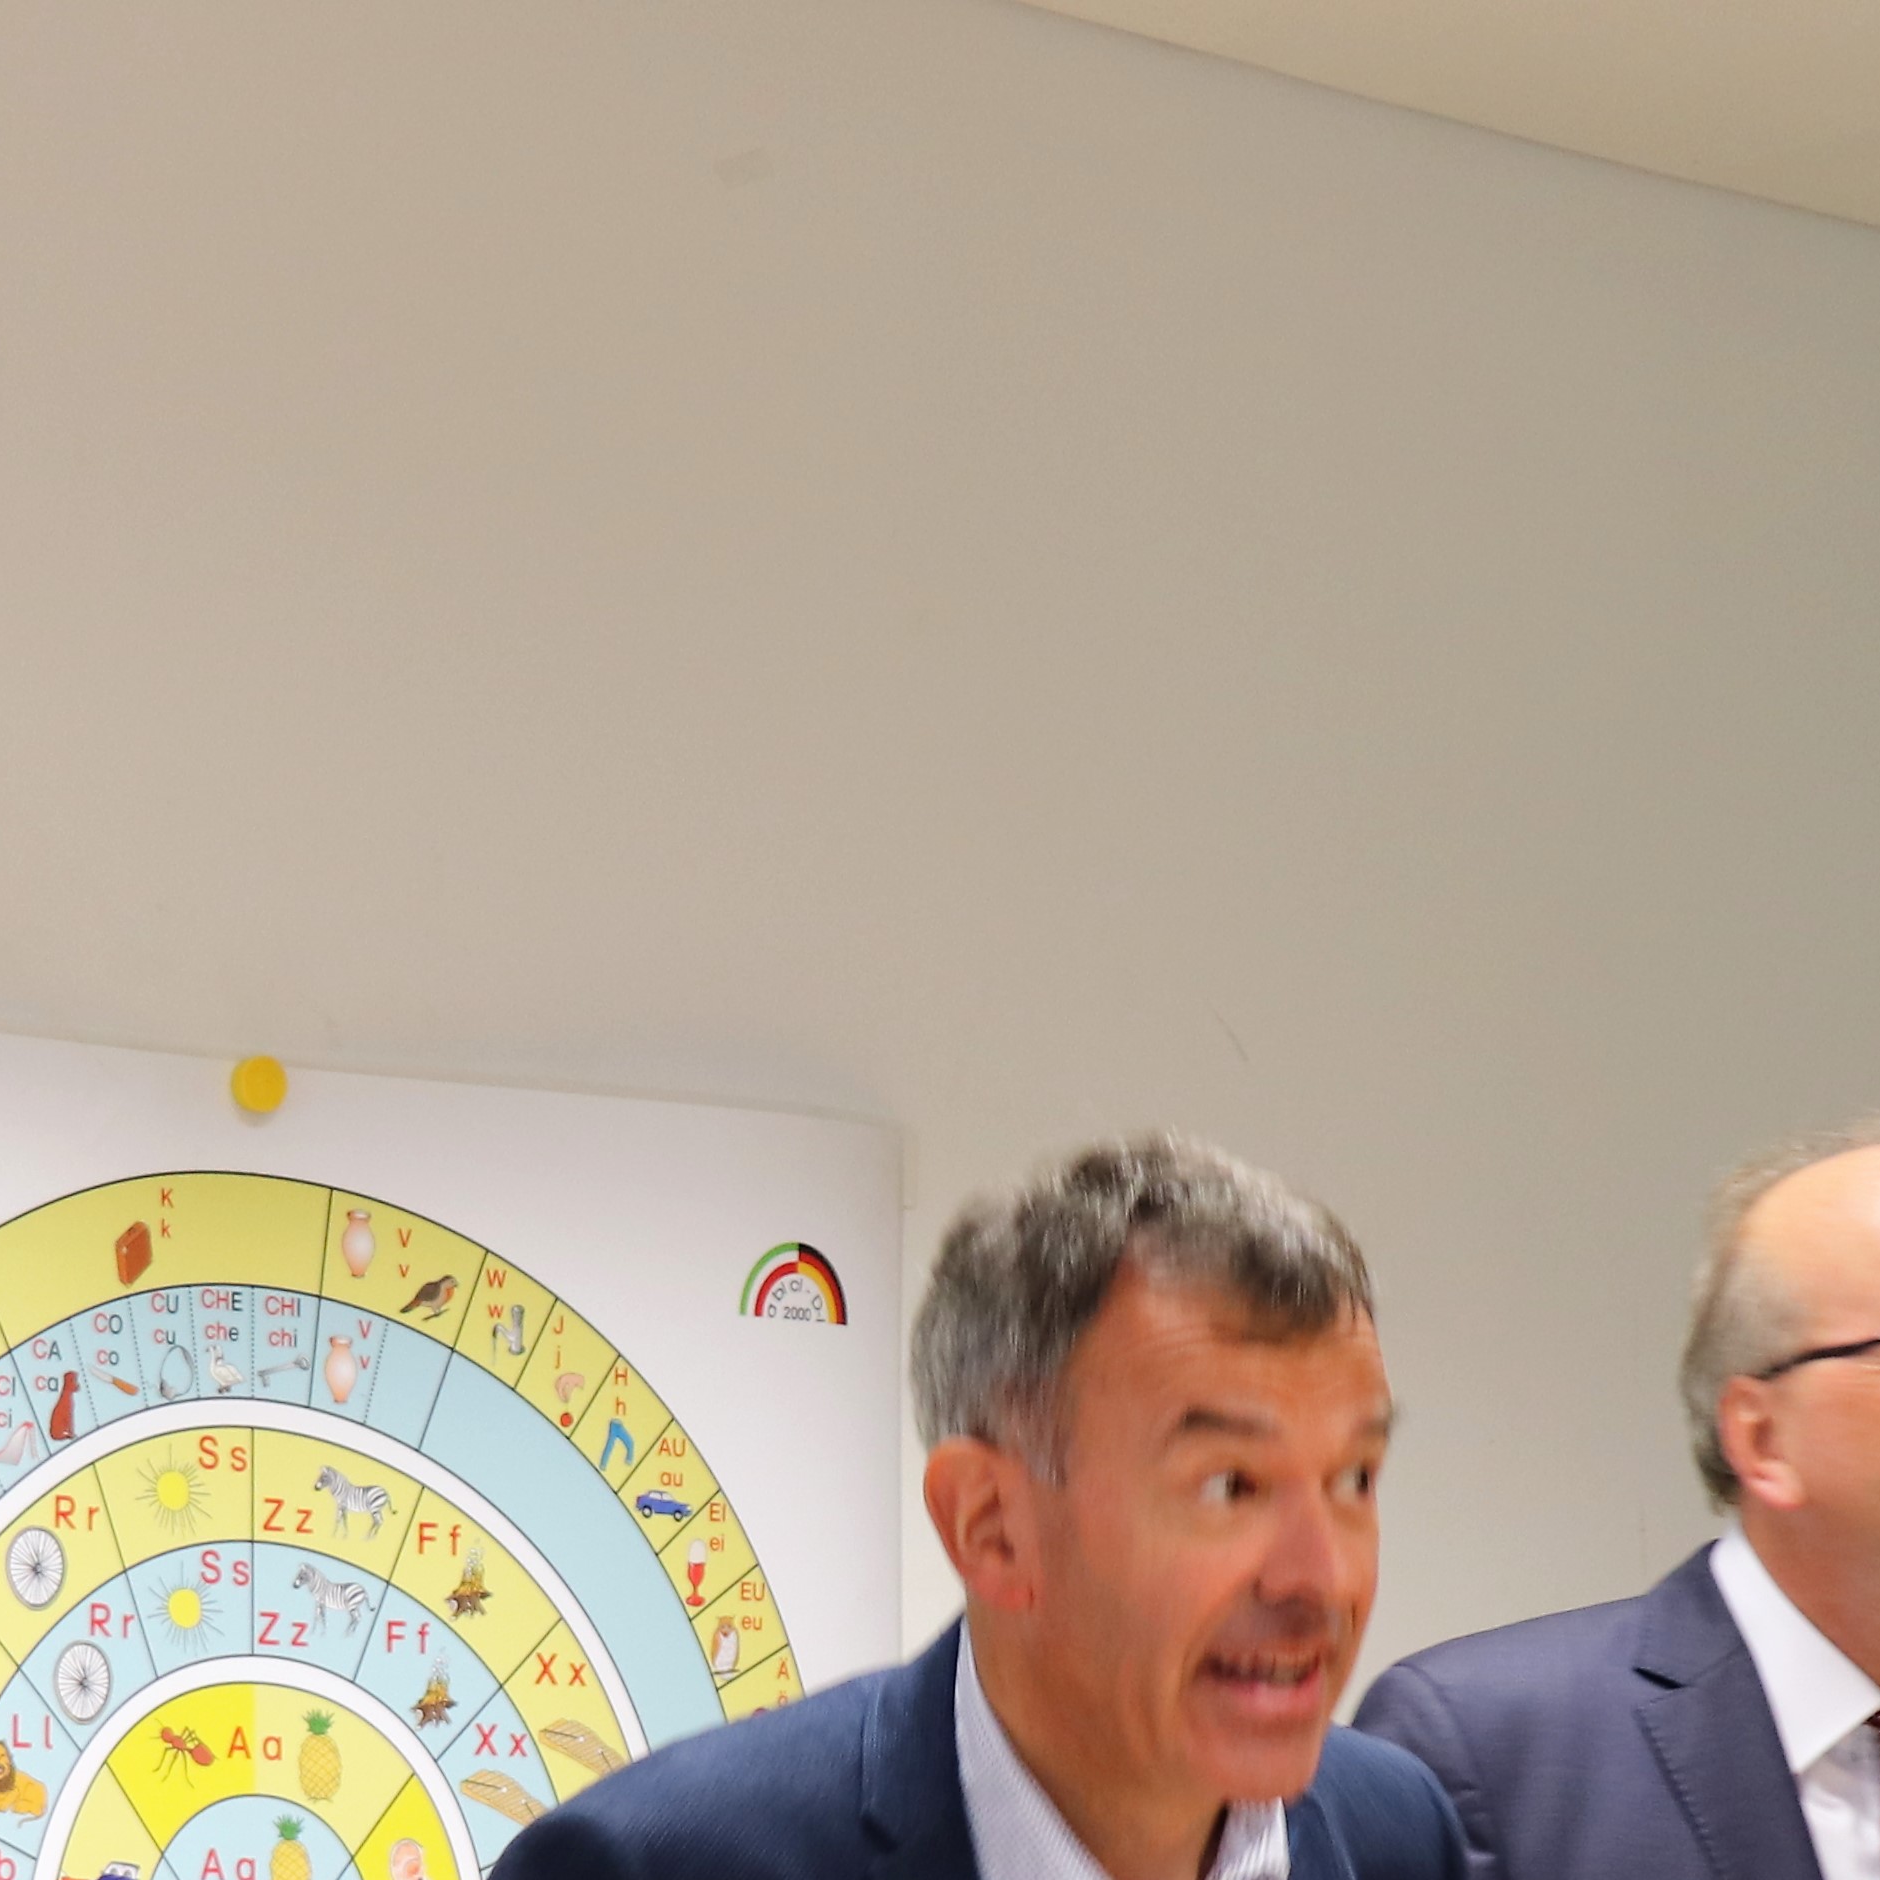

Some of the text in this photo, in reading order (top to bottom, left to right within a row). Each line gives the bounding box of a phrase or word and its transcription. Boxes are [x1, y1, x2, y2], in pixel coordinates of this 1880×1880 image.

[161, 1188, 173, 1207] K
[161, 1219, 170, 1238] k
[398, 1229, 411, 1248] V
[399, 1264, 409, 1278] v
[487, 1269, 506, 1288] W
[151, 1293, 179, 1314] CU
[202, 1289, 242, 1311] CHE
[265, 1296, 300, 1317] CHI
[488, 1305, 503, 1318] w
[783, 1306, 812, 1321] 2000
[94, 1313, 122, 1334] CO
[205, 1322, 239, 1341] che
[359, 1320, 372, 1339] V
[553, 1316, 564, 1334] J
[154, 1328, 176, 1345] cu
[269, 1328, 297, 1347] chi
[33, 1339, 61, 1360] CA
[97, 1350, 119, 1366] co
[555, 1346, 560, 1369] j
[360, 1356, 370, 1369] v
[35, 1376, 58, 1392] ca
[615, 1367, 627, 1385] H
[615, 1397, 626, 1415] h
[658, 1438, 685, 1457] AU
[660, 1472, 683, 1487] au
[709, 1504, 727, 1522] EI
[709, 1537, 724, 1551] ei
[740, 1582, 765, 1601] EU
[741, 1616, 762, 1631] eu
[777, 1657, 790, 1680] Ä
